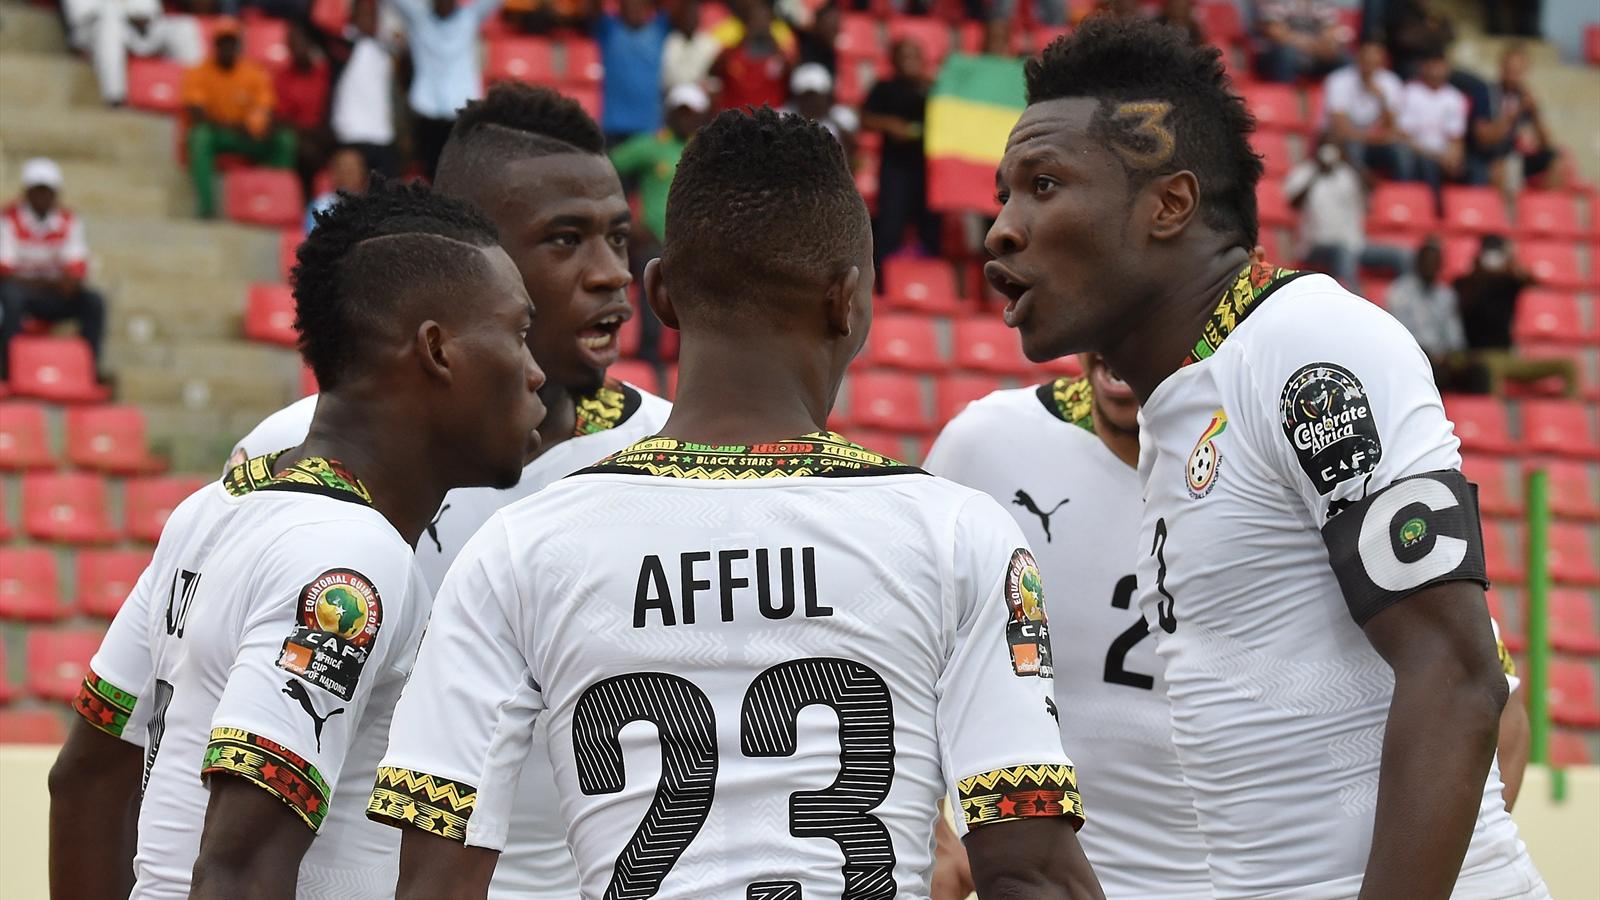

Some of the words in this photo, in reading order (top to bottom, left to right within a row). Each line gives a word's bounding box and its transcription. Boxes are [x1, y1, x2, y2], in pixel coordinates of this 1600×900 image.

[1111, 101, 1176, 169] 3
[1293, 405, 1367, 451] Celebrate
[1311, 423, 1354, 455] Africa
[616, 453, 654, 464] GHANA
[696, 456, 737, 467] BLACK
[739, 456, 774, 467] STARS
[820, 458, 861, 471] GHANA
[1358, 478, 1468, 592] C
[305, 575, 348, 613] EQUATORIAL
[350, 577, 377, 608] GUINEA
[632, 547, 834, 629] AFFUL
[306, 632, 355, 658] CAF
[315, 651, 344, 671] AFRICA
[308, 670, 319, 681] OF
[319, 674, 347, 697] NATIONS
[312, 660, 328, 674] CUP
[572, 657, 897, 899] 23
